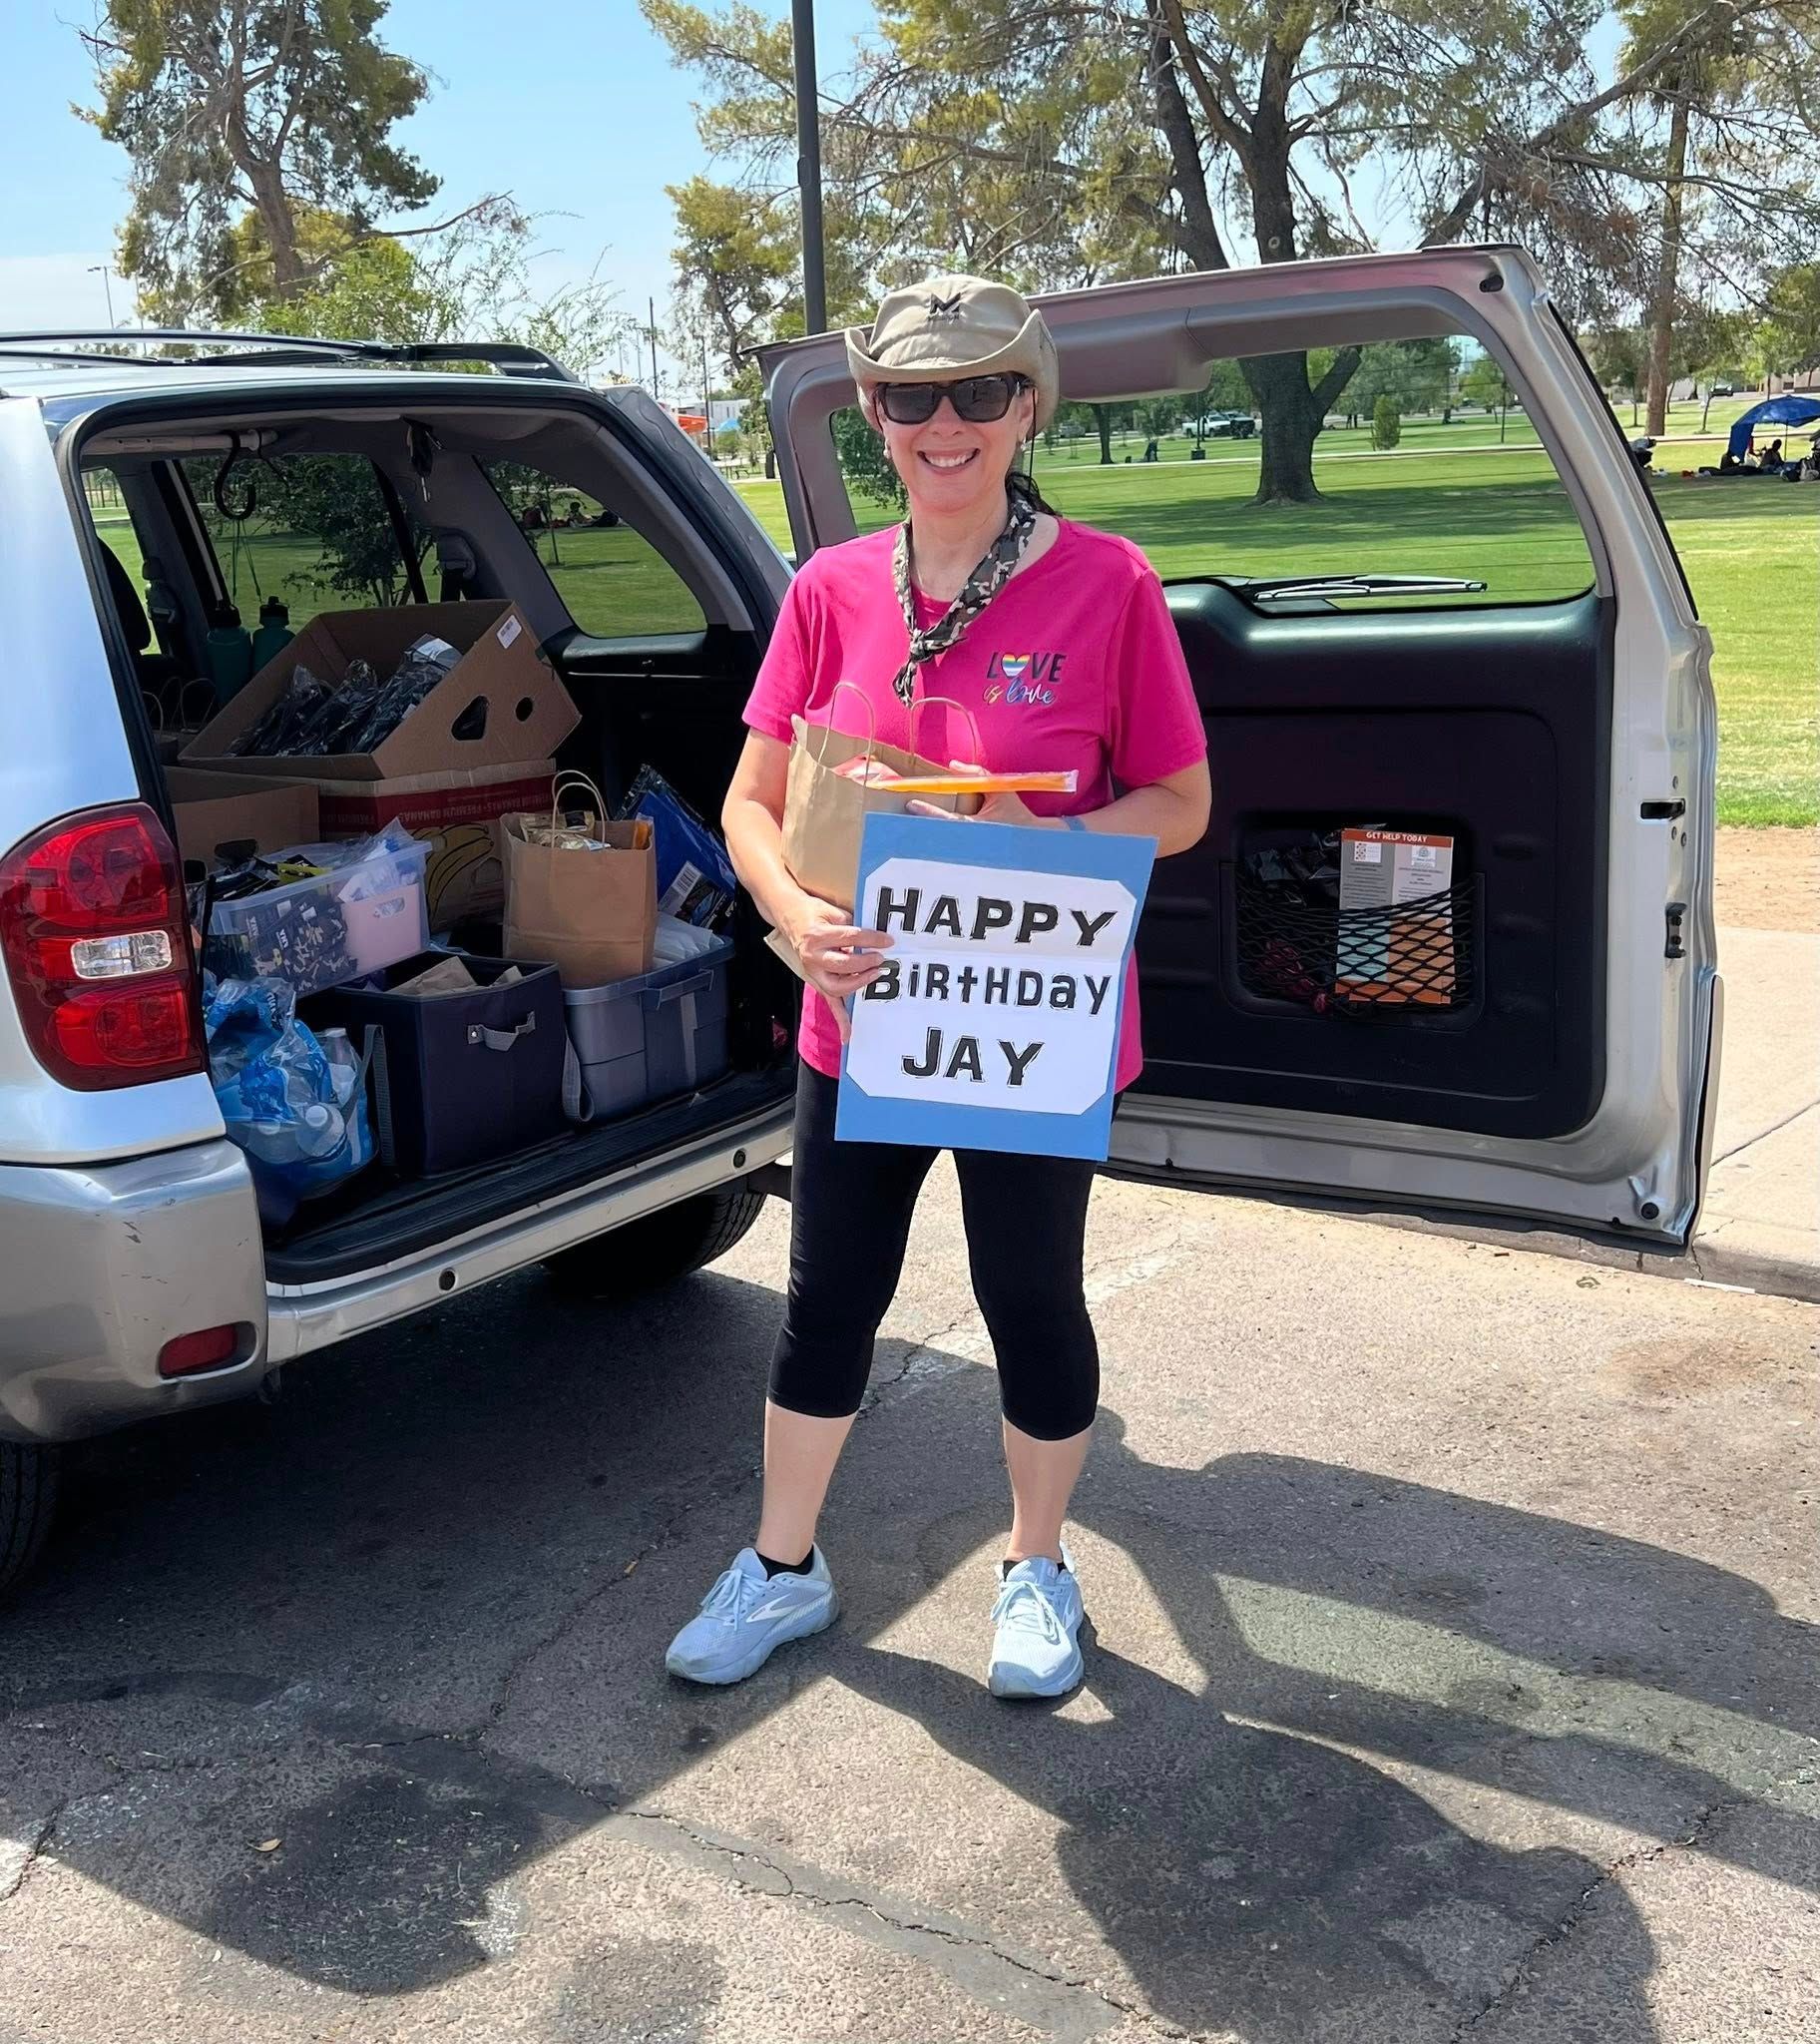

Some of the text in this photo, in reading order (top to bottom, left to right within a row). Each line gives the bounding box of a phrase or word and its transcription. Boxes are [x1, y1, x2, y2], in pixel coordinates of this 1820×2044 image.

[983, 677, 1055, 705] is love
[1366, 830, 1428, 843] GET HELP TODAY
[874, 885, 1119, 946] HAPPY
[901, 1026, 1046, 1089] JAY
